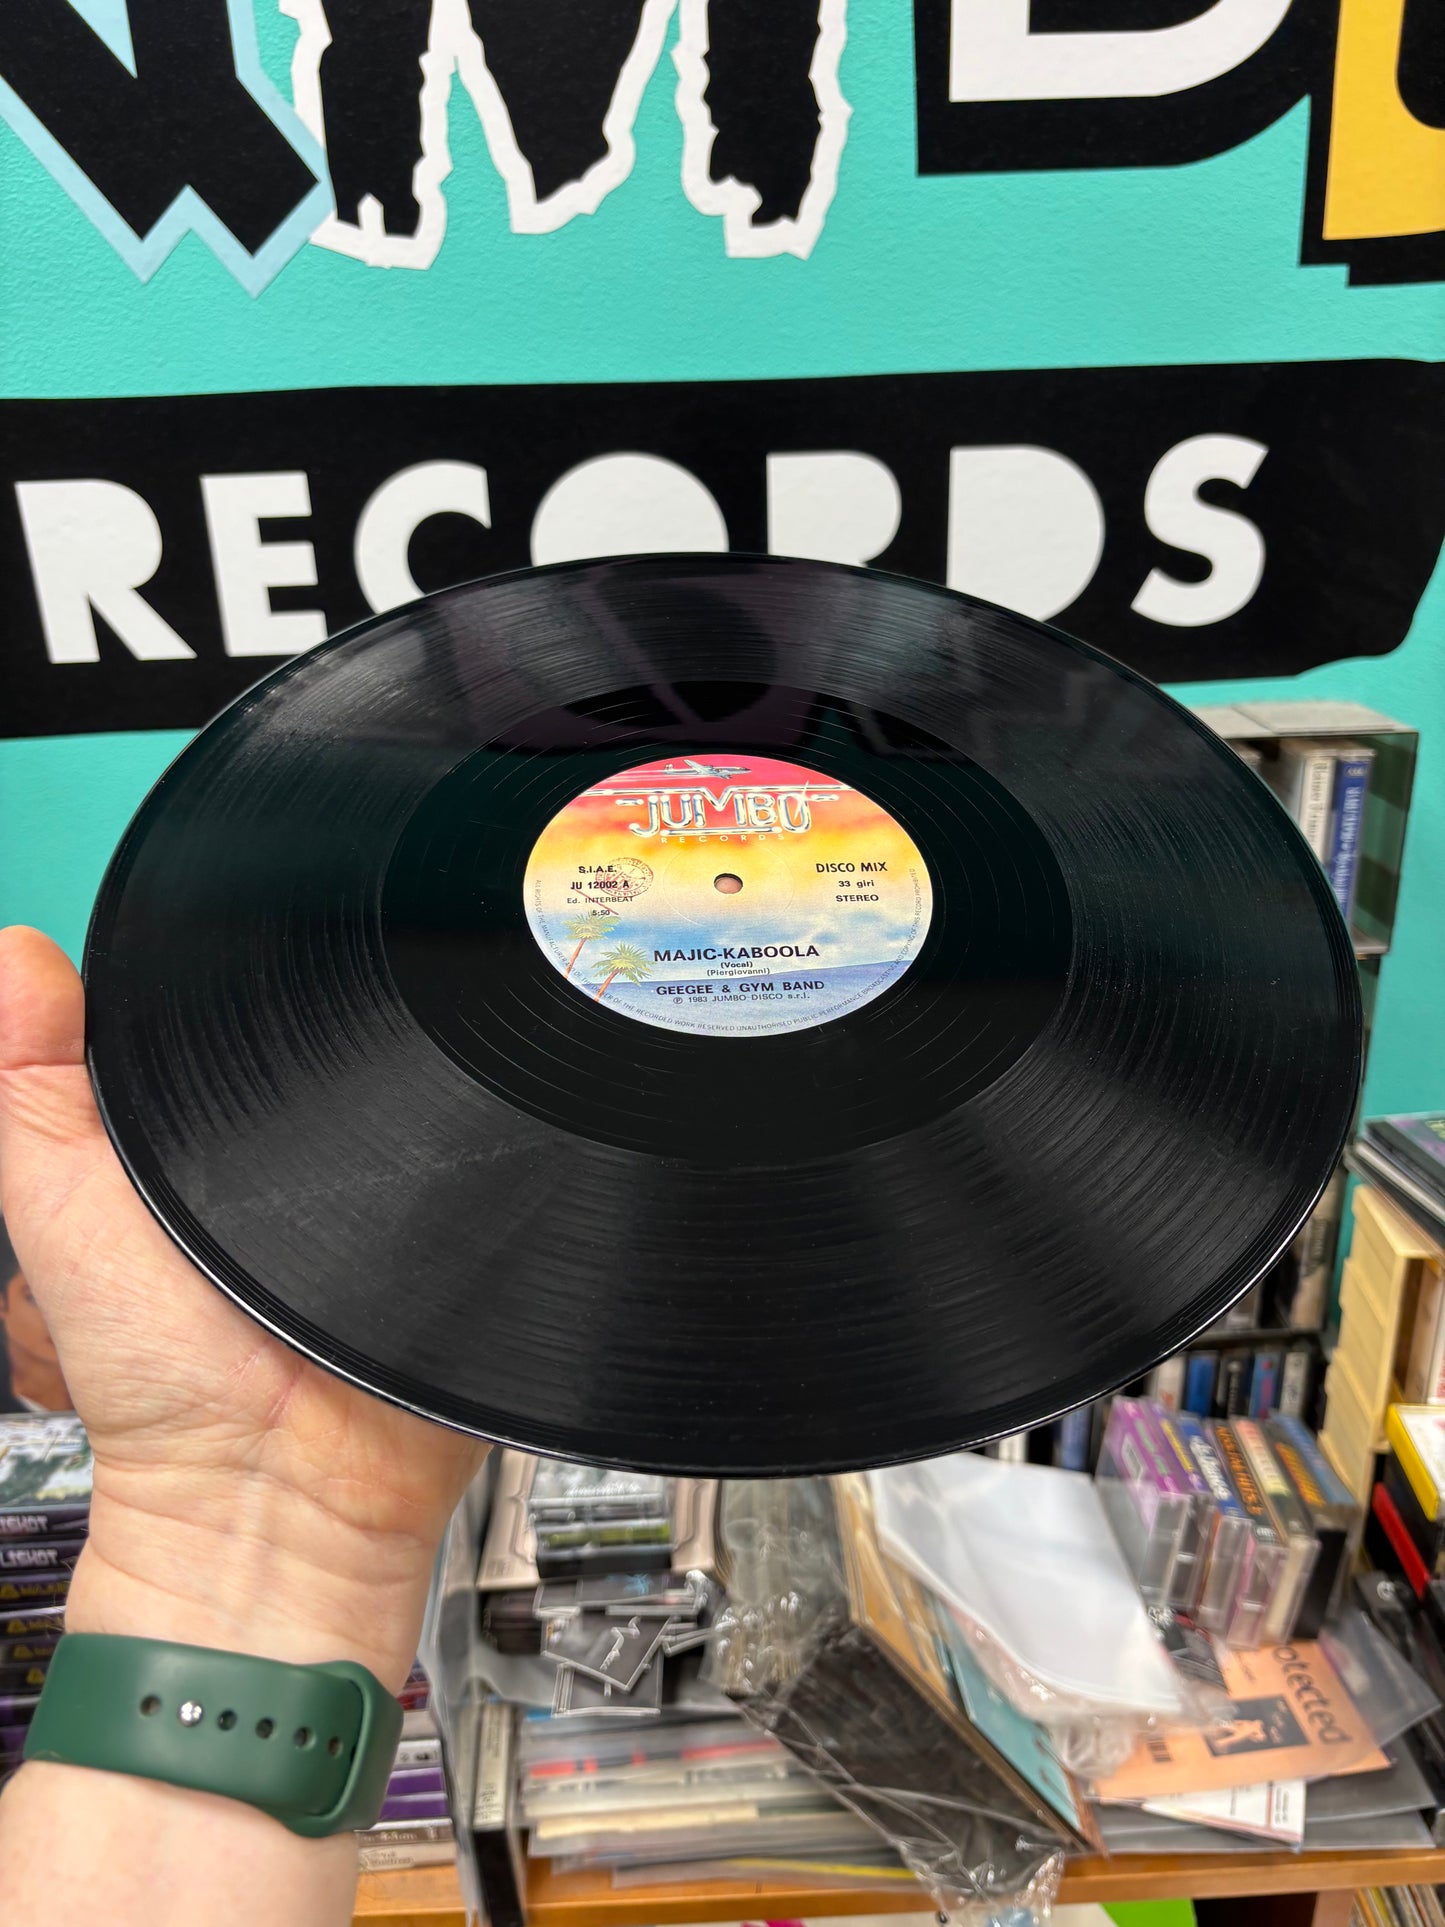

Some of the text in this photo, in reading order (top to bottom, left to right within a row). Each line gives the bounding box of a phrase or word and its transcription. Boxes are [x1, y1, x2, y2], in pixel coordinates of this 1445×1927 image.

[14, 433, 1270, 663] RECORDS
[629, 786, 813, 838] JUMBO
[660, 833, 785, 844] RECORDS
[578, 865, 617, 874] S.I.A.E.
[816, 861, 888, 873] DISCO MIX
[570, 880, 630, 890] JU 12002 A
[838, 879, 875, 889] 33 giri
[835, 894, 879, 902] STEREO
[654, 944, 820, 962] MAJIC-KABOOLA
[720, 961, 753, 969] (Vocal)
[706, 967, 771, 977] (Piergiovanni)
[656, 980, 825, 996] GEEGEE & GYM BAND
[712, 994, 746, 1003] JUMBO
[751, 992, 783, 1001] DISCO
[787, 992, 810, 1000] s.r.l.
